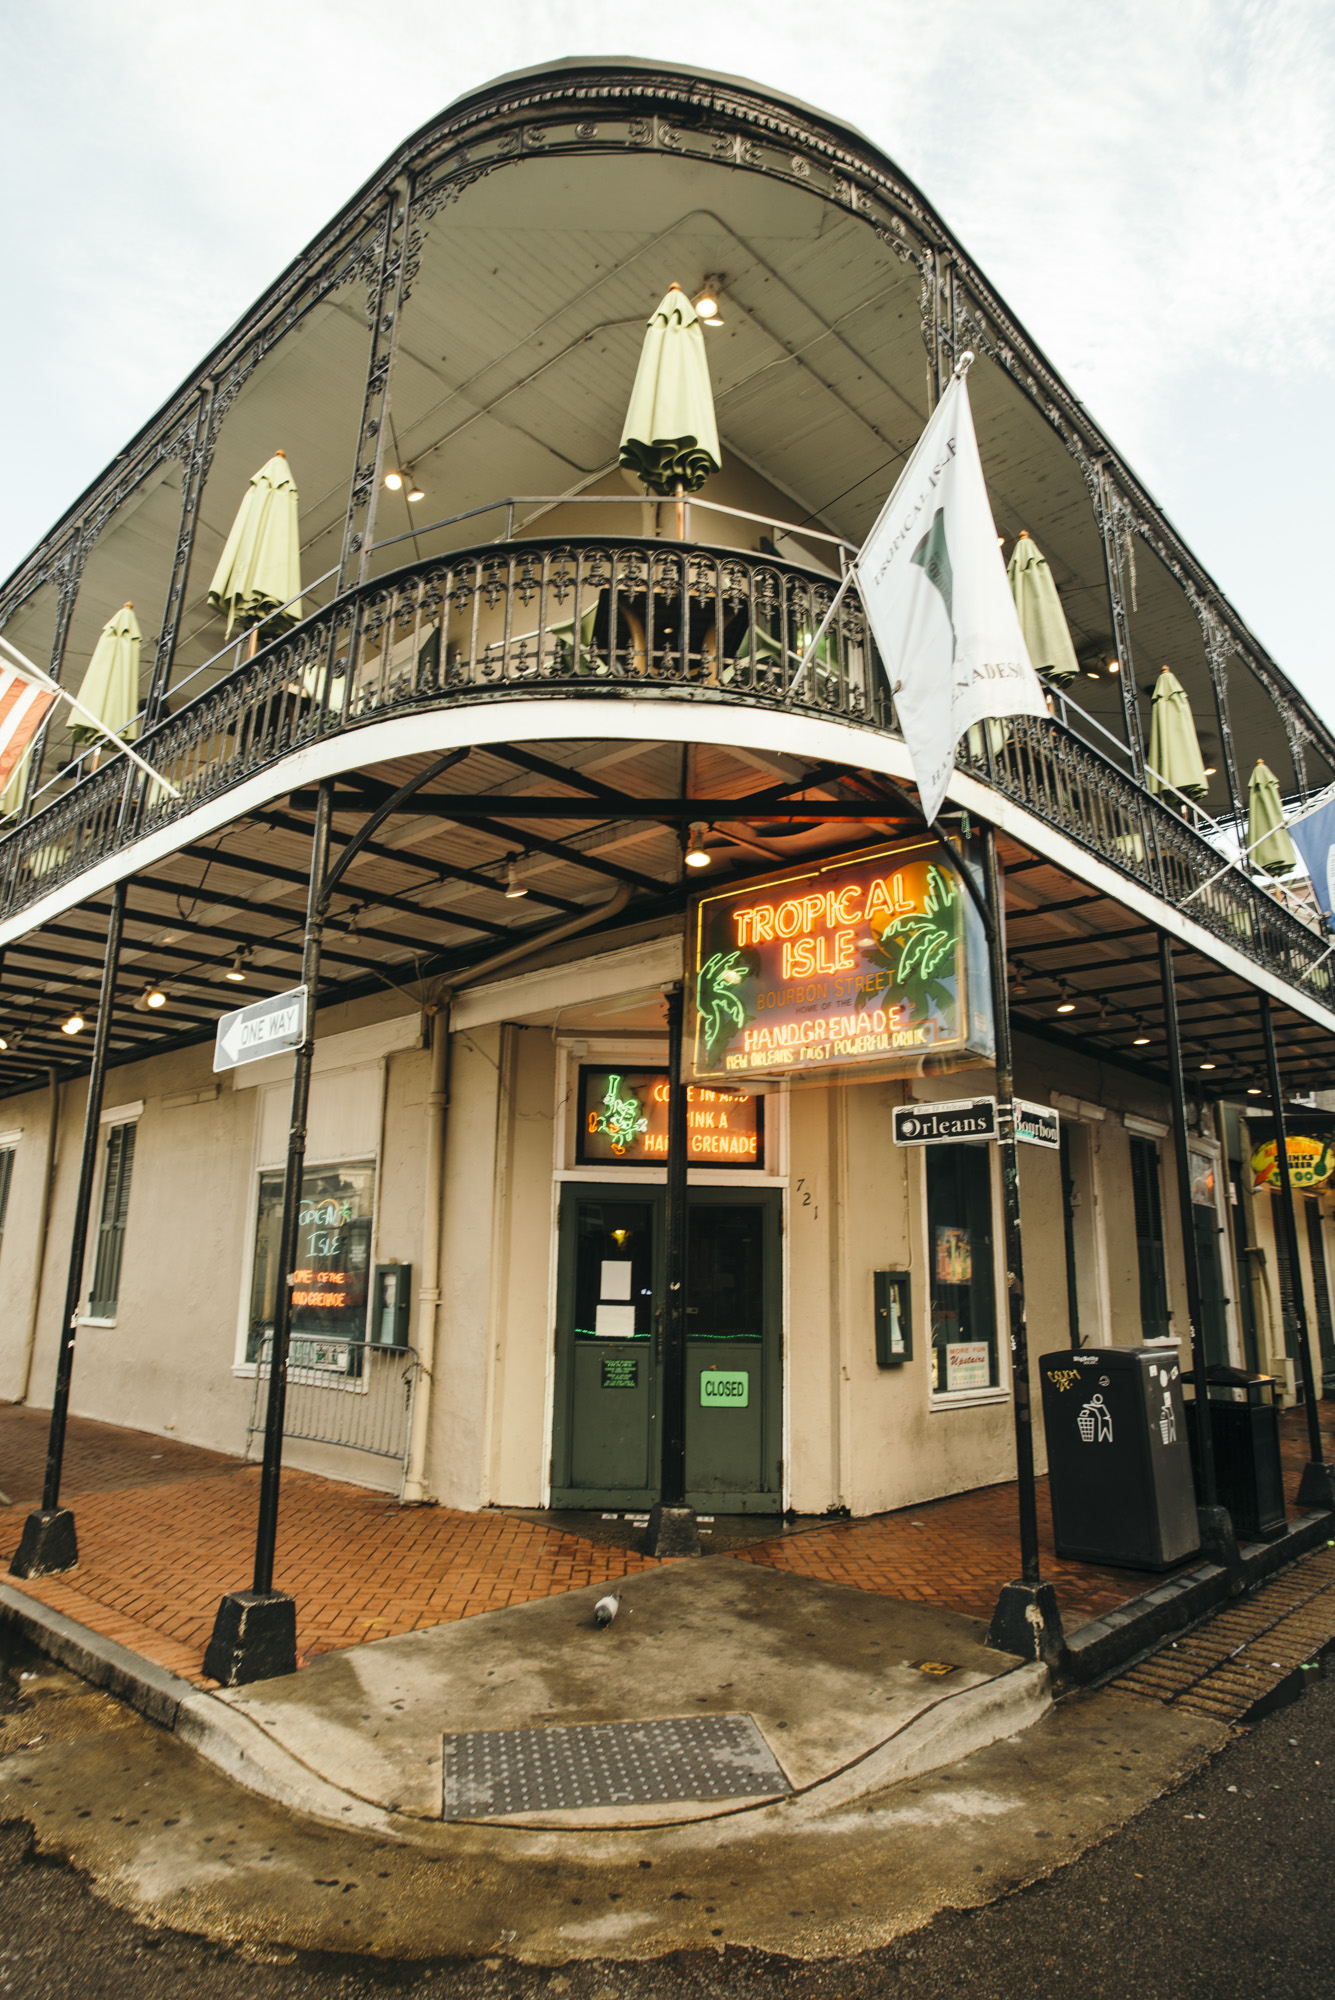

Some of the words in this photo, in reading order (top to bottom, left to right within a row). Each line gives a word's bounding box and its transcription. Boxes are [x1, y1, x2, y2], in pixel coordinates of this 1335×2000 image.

[733, 873, 915, 947] TROPICAL
[782, 929, 856, 980] ISLE
[756, 982, 828, 1011] BOURBON
[834, 969, 896, 998] STREET
[795, 1003, 818, 1015] HOME
[821, 1001, 832, 1011] OF
[836, 998, 852, 1008] THE
[241, 1018, 265, 1046] ONE
[268, 1009, 296, 1038] WAY
[744, 1006, 902, 1052] HANDGRENADE
[726, 1055, 748, 1071] NEW
[750, 1048, 794, 1067] ORLEANS
[799, 1043, 832, 1061] MOST
[834, 1033, 891, 1057] POWERFUL
[892, 1028, 927, 1048] DRINK
[653, 1085, 695, 1102] COE
[700, 1088, 716, 1102] IN
[687, 1111, 715, 1128] INK
[718, 1112, 729, 1128] A
[901, 1116, 987, 1137] Orleans
[1014, 1112, 1058, 1141] Bourbon
[644, 1134, 669, 1152] HA
[692, 1134, 757, 1154] GRENADE
[1274, 1154, 1314, 1162] DINKS
[1294, 1171, 1313, 1182] GO
[293, 1269, 313, 1284] OME
[949, 1347, 969, 1355] MORE
[950, 1355, 985, 1367] Upstairs
[705, 1380, 744, 1397] CLOSED
